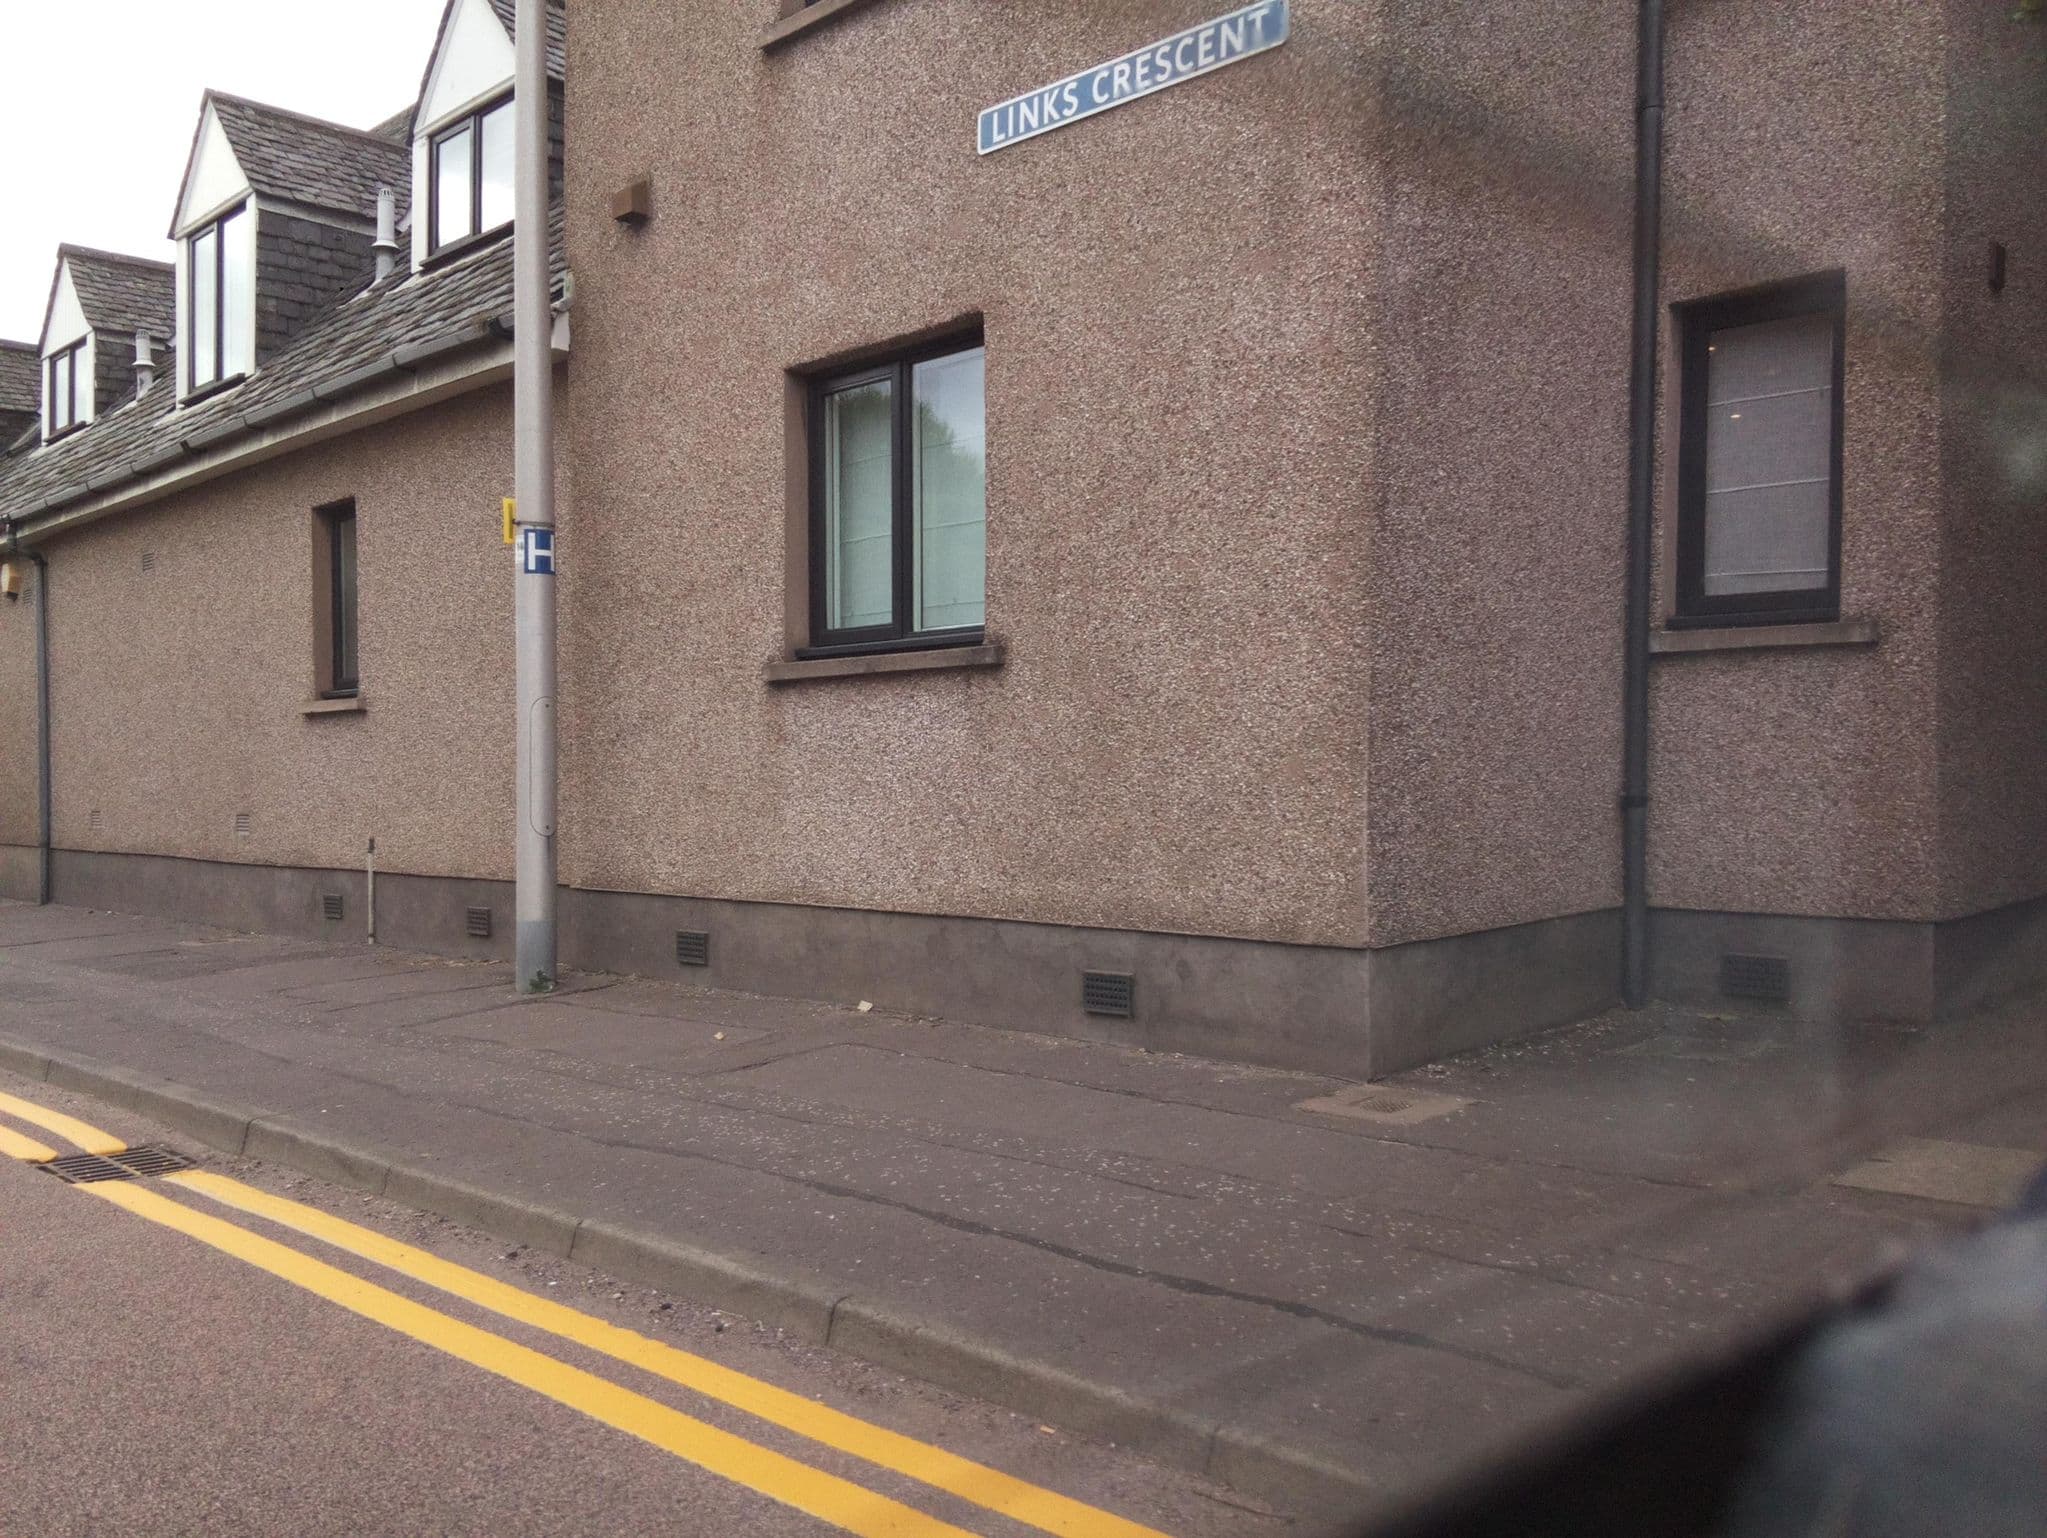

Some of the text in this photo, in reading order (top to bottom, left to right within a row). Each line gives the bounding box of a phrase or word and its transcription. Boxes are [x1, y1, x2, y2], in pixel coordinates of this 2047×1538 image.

[992, 8, 1270, 144] LINKS CRESCENT
[528, 532, 555, 572] H
